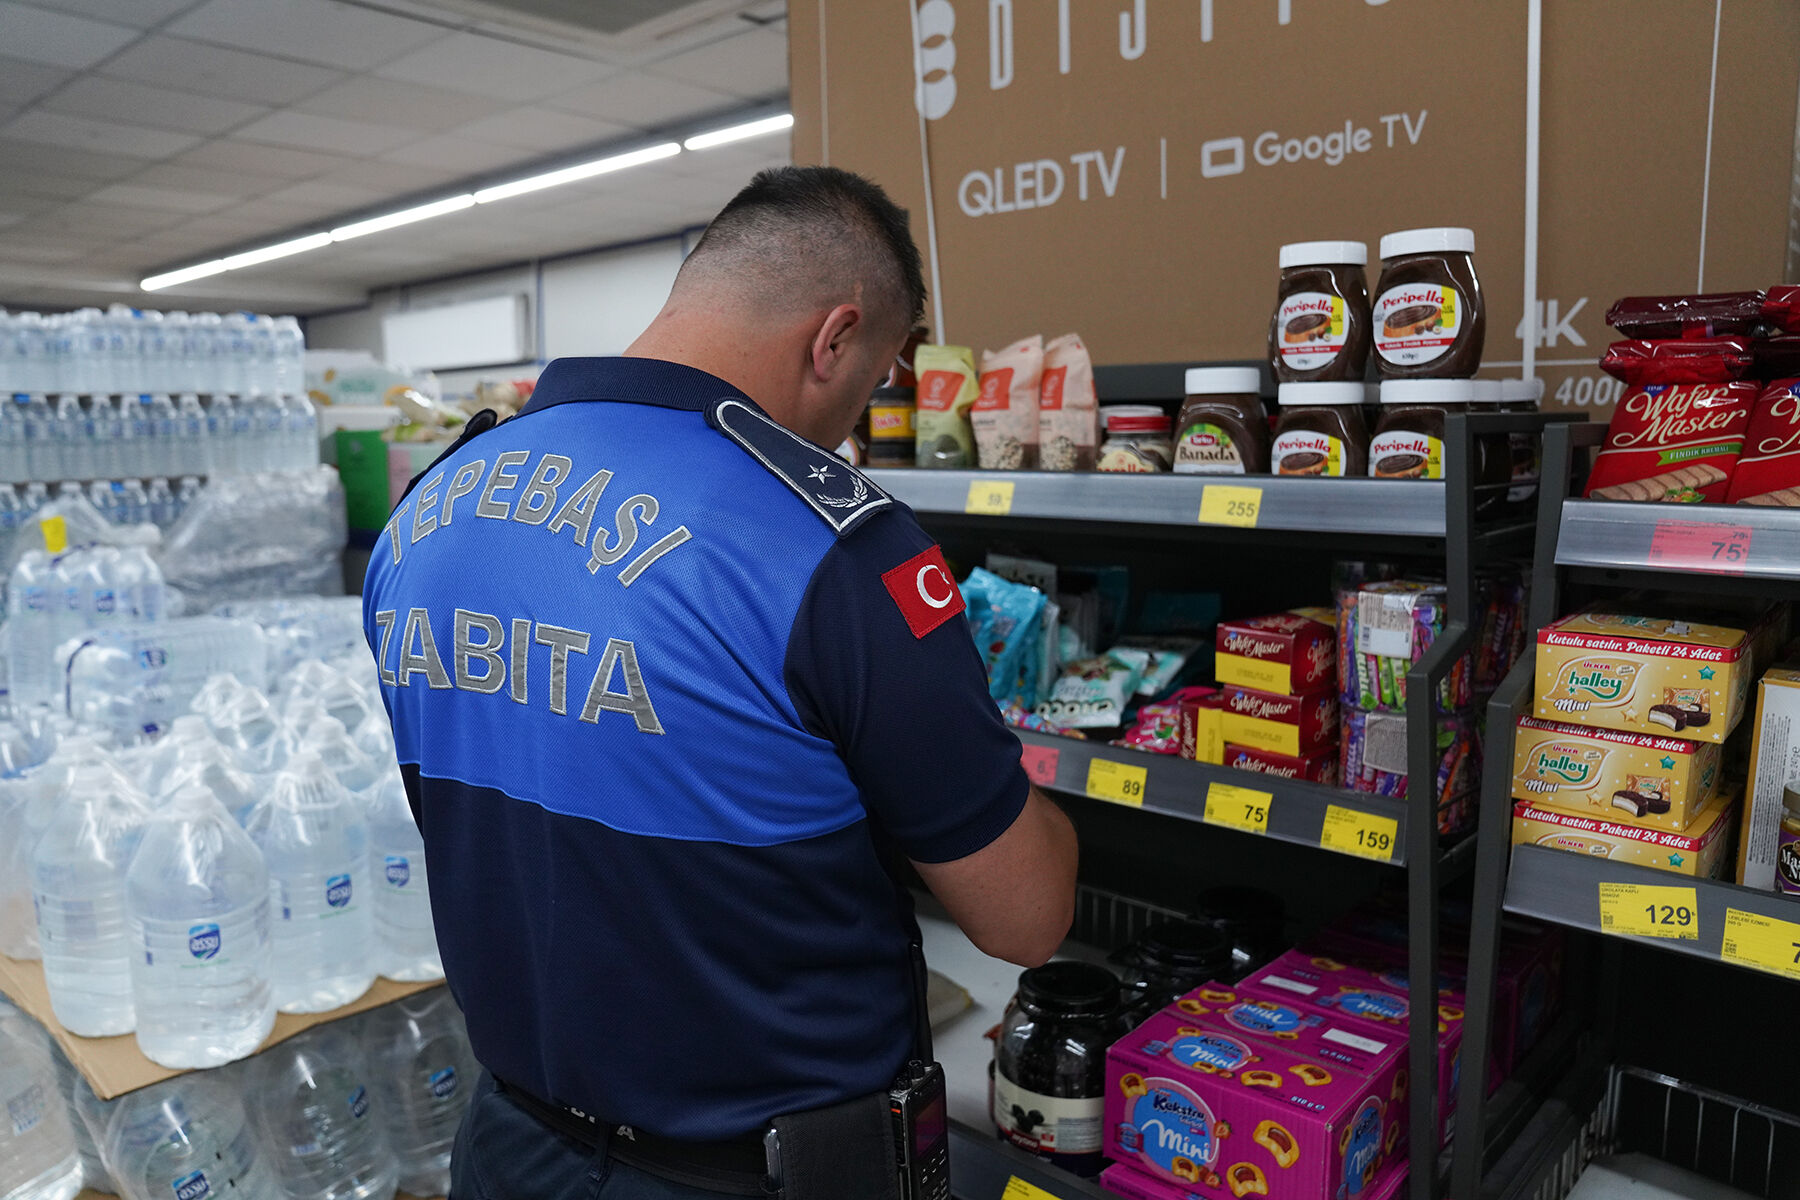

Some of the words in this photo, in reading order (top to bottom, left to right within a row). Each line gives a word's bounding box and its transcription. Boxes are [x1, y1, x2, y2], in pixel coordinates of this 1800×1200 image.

[1253, 120, 1372, 166] Google
[1379, 110, 1428, 148] TV
[958, 159, 1064, 217] QLED
[1071, 147, 1126, 201] TV
[1283, 299, 1335, 316] Peripella
[1382, 290, 1445, 310] Peripella
[1625, 384, 1729, 422] Wafer
[1613, 409, 1747, 446] Master
[1179, 446, 1235, 462] Banada
[1278, 438, 1332, 454] Peripella
[1374, 440, 1432, 455] Peripella
[385, 450, 693, 588] TEPEBAŞI
[1226, 500, 1256, 518] 255
[1711, 541, 1742, 562] 75
[1546, 633, 1584, 647] Kutulu
[1626, 641, 1669, 656] Paketli
[1671, 646, 1688, 658] 24
[1689, 648, 1723, 661] Adet
[375, 607, 667, 736] ZABITA
[1569, 671, 1622, 699] halley
[1554, 698, 1591, 713] Mini
[1519, 715, 1556, 731] Kutulu
[1594, 728, 1636, 745] Paketli
[1638, 735, 1654, 747] 24
[1654, 738, 1687, 752] Adet
[1539, 752, 1590, 782] halley
[1122, 779, 1141, 796] 89
[1525, 778, 1561, 795] Mini
[1244, 804, 1265, 824] 75
[1356, 829, 1390, 850] 159
[1522, 807, 1560, 823] Kutulu
[1599, 823, 1641, 840] Paketli
[1642, 831, 1658, 844] 24
[1659, 835, 1692, 850] Adet
[1645, 904, 1692, 927] 129
